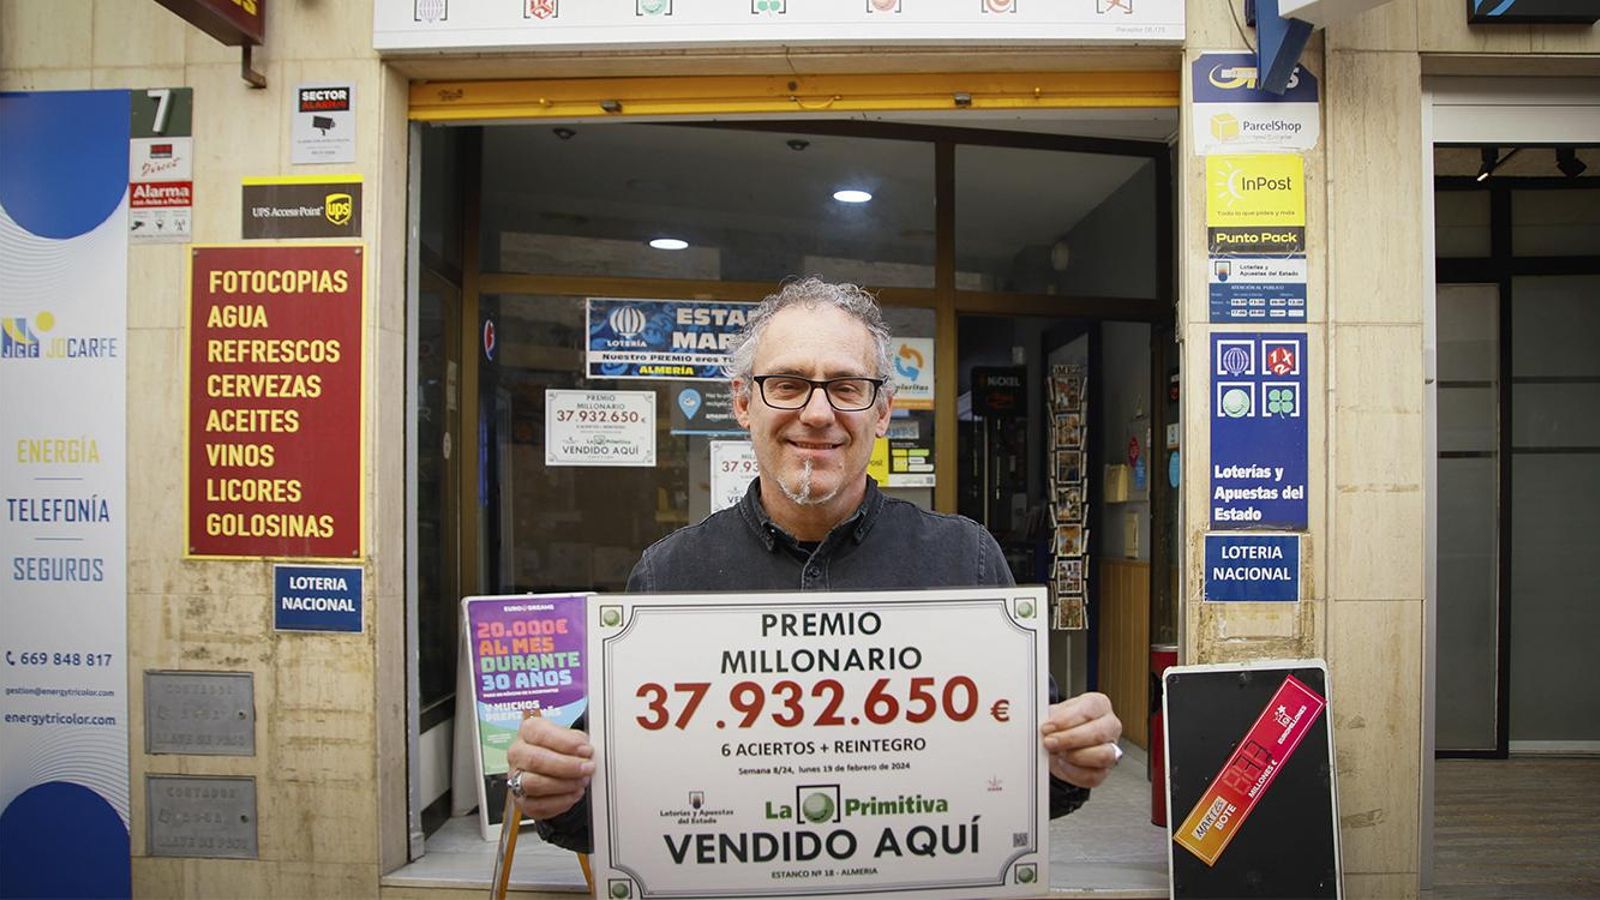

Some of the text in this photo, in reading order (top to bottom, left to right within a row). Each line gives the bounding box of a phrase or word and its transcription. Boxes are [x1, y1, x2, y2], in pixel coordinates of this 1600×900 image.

[302, 90, 348, 101] SECTOR
[147, 89, 170, 132] 7
[1243, 120, 1302, 133] ParcelShop
[133, 185, 190, 198] Alarma
[1242, 177, 1292, 191] InPost
[252, 207, 269, 217] UPS
[271, 208, 298, 217] Access
[328, 203, 349, 219] ups
[1216, 232, 1298, 243] Punto Pack
[209, 270, 348, 294] FOTOCOPIAS
[207, 305, 268, 328] AGUA
[46, 337, 118, 358] JOCARFE
[207, 340, 341, 363] REFRESCOS
[607, 340, 647, 348] LOTERÍA
[602, 353, 647, 361] Nuestro
[650, 354, 692, 362] PREMIO
[639, 365, 694, 375] ALMERÍA
[207, 374, 321, 398] CERVEZAS
[206, 409, 299, 433] ACEITES
[557, 410, 639, 423] 37.932.650
[17, 436, 101, 464] ENERGÍA
[206, 444, 275, 467] VINOS
[562, 445, 639, 455] VENDIDO AQUÍ
[1214, 464, 1284, 482] Loterías y
[207, 479, 302, 502] LICORES
[1214, 485, 1304, 503] Apuestas del
[7, 495, 110, 522] TELEFONÍA
[1214, 507, 1262, 521] Estado
[206, 514, 334, 538] GOLOSINAS
[1221, 546, 1283, 559] LOTERIA
[13, 558, 104, 582] SEGUROS
[1213, 567, 1291, 580] NACIONAL
[289, 576, 348, 591] LOTERIA
[281, 597, 356, 612] NACIONAL
[477, 619, 569, 638] 20.000€
[761, 612, 882, 637] PREMIO
[480, 636, 555, 656] AL MES
[20, 652, 112, 666] 669 848 817
[481, 651, 581, 673] DURANTE
[720, 647, 922, 674] MILLONARIO
[482, 669, 572, 691] 30 AÑOS
[5, 687, 115, 697] gestion@energytricolor.com
[635, 675, 1010, 731] 37.932.650 €
[4, 713, 116, 726] energytricolor.com
[721, 737, 927, 757] 6 ACIERTOS + REINTEGRO
[738, 767, 771, 776] Semana
[773, 766, 795, 775] 8/24,
[799, 764, 821, 773] lunes
[835, 763, 844, 772] de
[847, 761, 877, 771] febrero
[879, 762, 889, 770] de
[891, 762, 911, 770] 2024
[1248, 764, 1274, 799] MILLONES
[660, 809, 691, 817] Loterías
[700, 808, 734, 818] Apuestas
[765, 797, 948, 819] La Primitiva
[1214, 803, 1236, 831] BOTE
[663, 815, 981, 864] VENDIDO AQUÍ
[771, 870, 809, 879] ESTANCO
[812, 869, 822, 877] Nº
[824, 869, 834, 877] 18
[841, 867, 878, 877] ALMERIA
